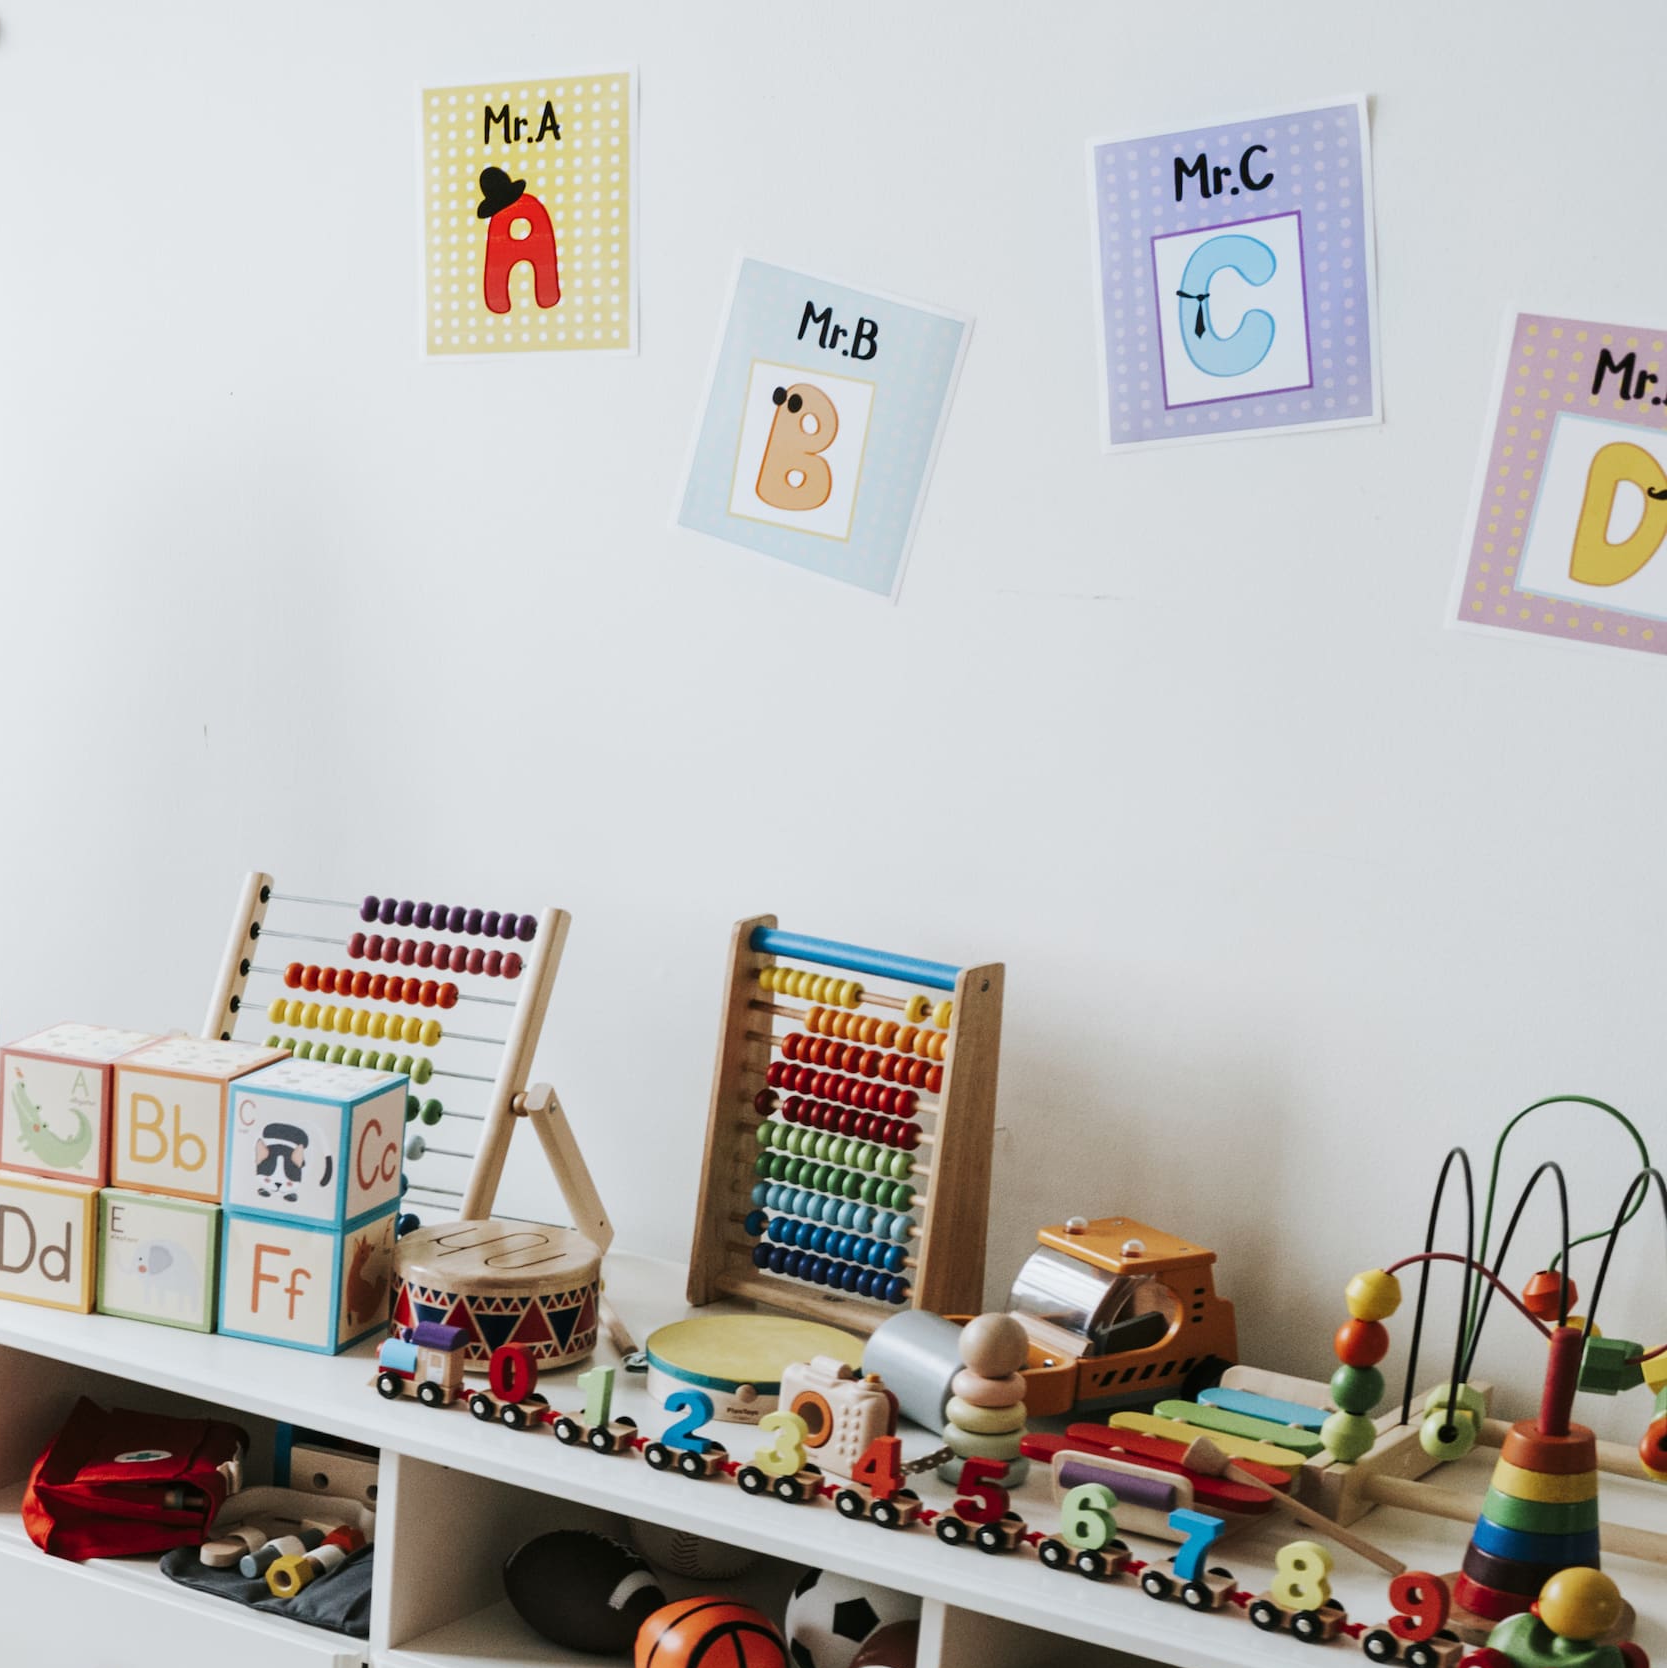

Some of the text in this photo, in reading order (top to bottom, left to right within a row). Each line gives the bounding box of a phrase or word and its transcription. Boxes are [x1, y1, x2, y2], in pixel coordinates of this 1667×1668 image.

[482, 100, 561, 145] Mr.A
[1172, 144, 1275, 203] Mr.C
[797, 300, 880, 364] Mr.B
[1591, 347, 1667, 406] Mr.
[70, 1069, 91, 1097] A
[238, 1098, 257, 1127] C
[129, 1091, 208, 1173] Bb
[356, 1117, 398, 1192] Cc
[110, 1205, 126, 1233] E
[250, 1241, 312, 1321] Ff
[663, 1388, 714, 1455] 2
[754, 1409, 809, 1477] 3
[851, 1434, 902, 1500] 4
[956, 1456, 1011, 1525] 5
[1060, 1481, 1118, 1551] 6
[1167, 1506, 1225, 1583] 7
[1271, 1539, 1334, 1612] 8
[1386, 1569, 1451, 1642] 9
